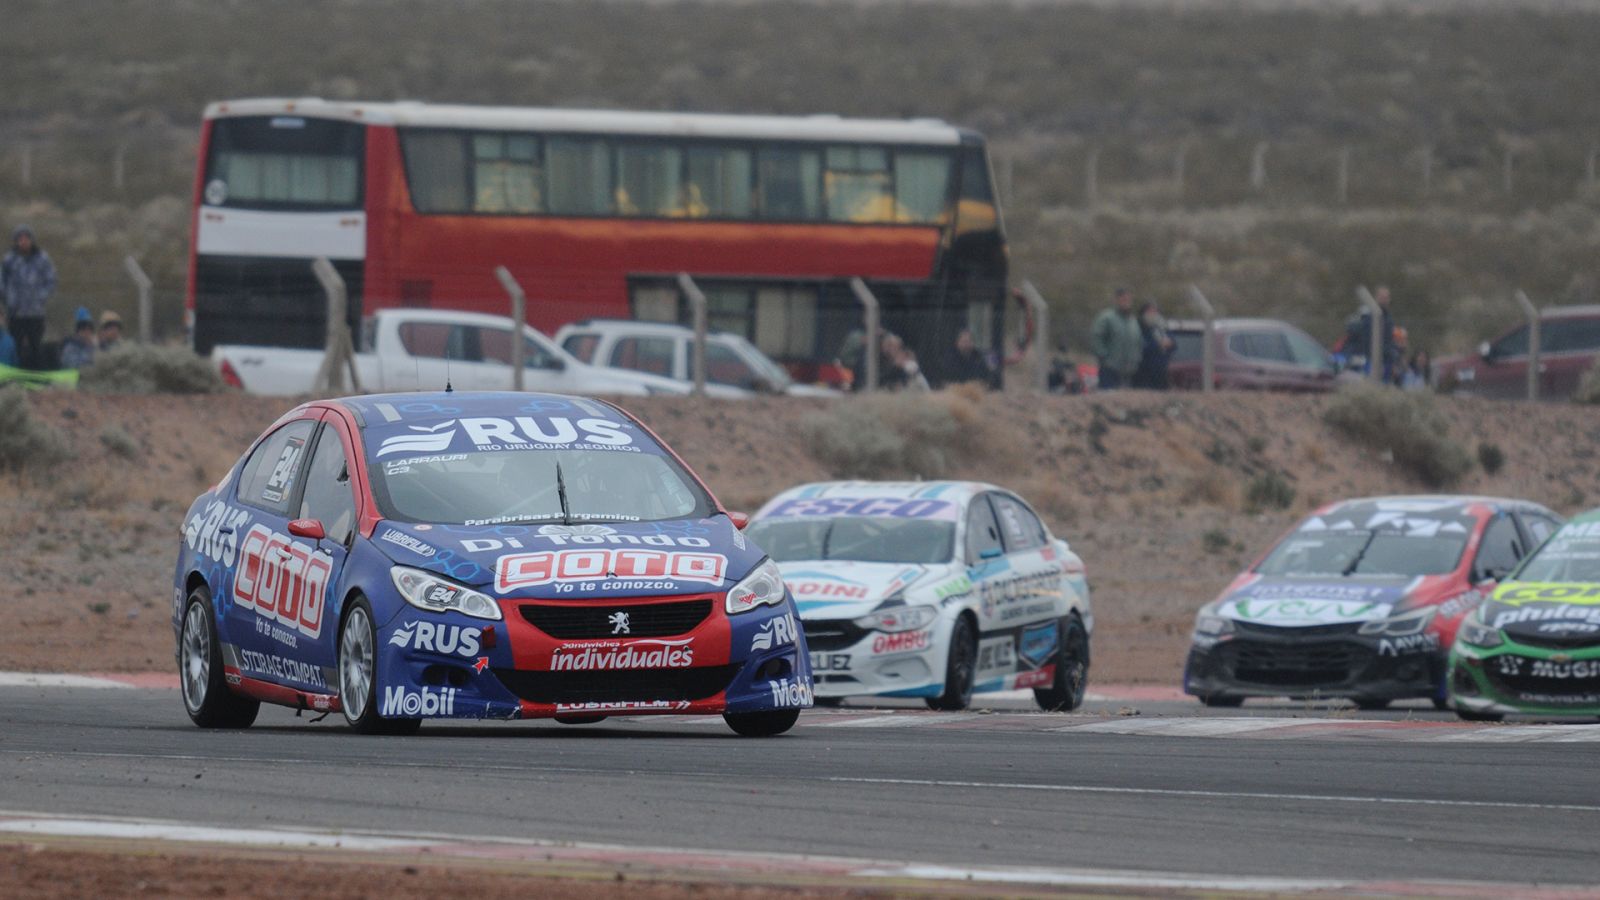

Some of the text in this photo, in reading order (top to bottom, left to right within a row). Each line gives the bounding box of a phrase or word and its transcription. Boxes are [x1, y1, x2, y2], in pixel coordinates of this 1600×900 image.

[460, 417, 632, 445] RUS
[575, 443, 640, 452] SEGUROS
[387, 454, 467, 468] LARRAURI
[388, 466, 410, 475] C3
[465, 513, 550, 526] Parabrisas
[198, 500, 249, 568] RUS
[384, 529, 430, 556] LUBRIFILM
[460, 533, 710, 553] Di Tondo
[235, 525, 332, 637] COTO
[497, 550, 726, 591] COTO
[430, 587, 454, 603] 24
[553, 581, 679, 593] Yo te conozco.
[255, 616, 298, 648] Yo te conozco.
[414, 621, 481, 657] RUS
[550, 646, 693, 671] individuales
[382, 686, 455, 715] Mobil
